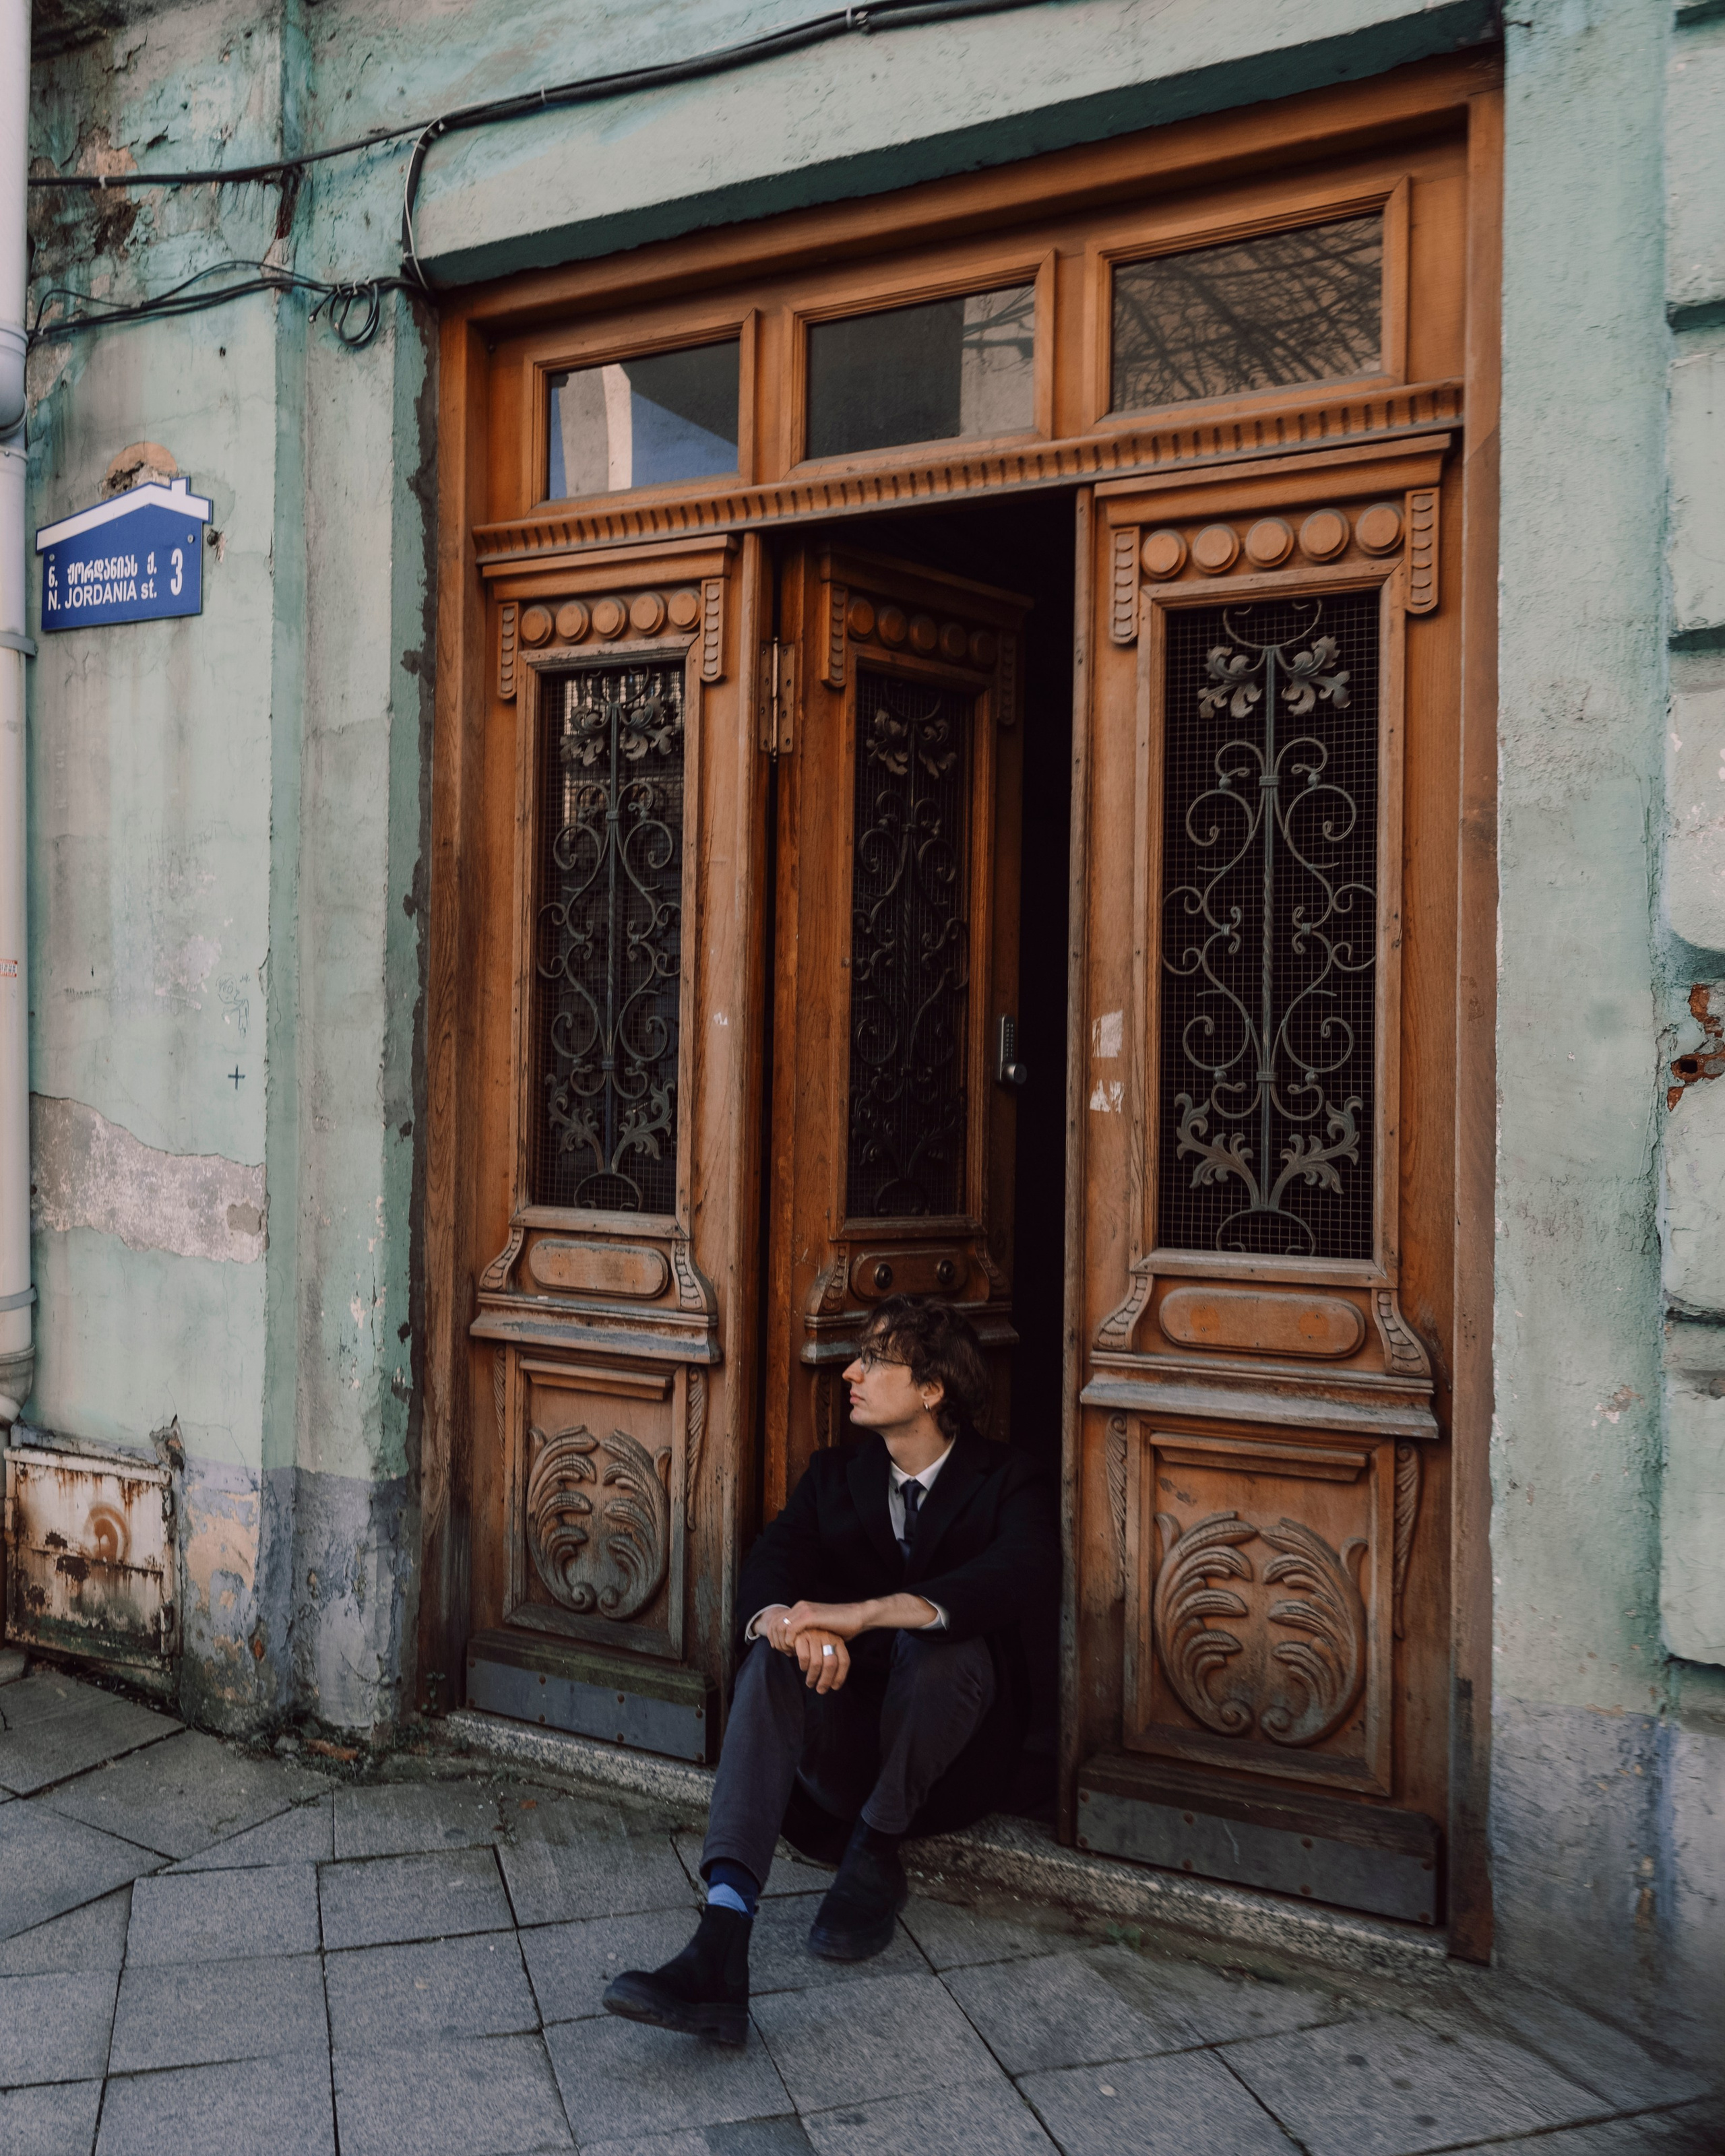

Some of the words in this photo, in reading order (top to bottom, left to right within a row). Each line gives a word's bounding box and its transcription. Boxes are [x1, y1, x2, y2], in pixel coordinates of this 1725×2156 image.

[48, 566, 59, 588] ნ.
[170, 548, 183, 596] 3
[48, 590, 61, 610] N.
[65, 579, 137, 609] JORDANIA
[141, 577, 158, 599] st.
